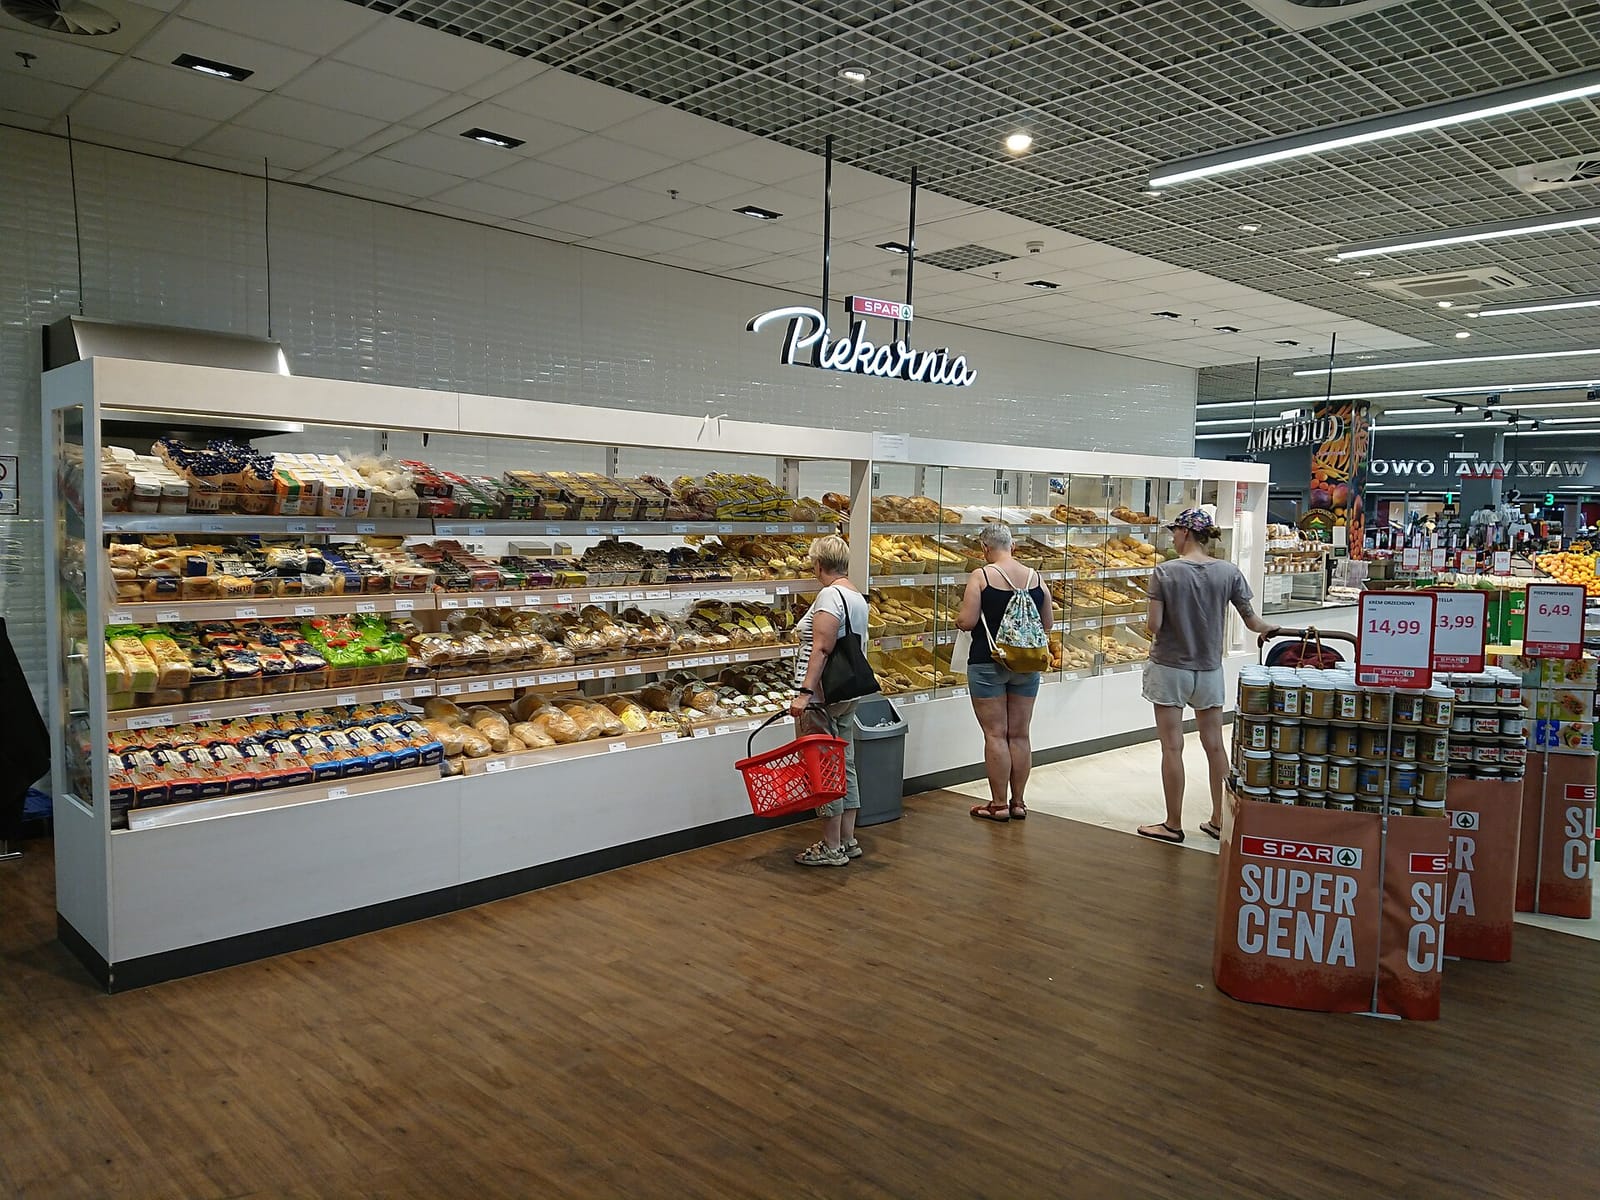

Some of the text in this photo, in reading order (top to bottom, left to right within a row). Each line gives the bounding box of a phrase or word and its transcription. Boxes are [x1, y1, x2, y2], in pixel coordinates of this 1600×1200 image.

[864, 301, 900, 316] SPAR
[747, 306, 977, 387] Piekarnia
[1446, 491, 1453, 505] 1
[1512, 489, 1521, 502] 2
[1544, 493, 1554, 506] 3
[1538, 604, 1570, 617] 6,49
[1368, 619, 1421, 636] 14,99
[1478, 747, 1500, 755] nutella
[1503, 748, 1526, 756] nutella
[1263, 842, 1332, 861] SPAR
[1240, 863, 1358, 917] SUPER
[1237, 903, 1356, 967] CENA
